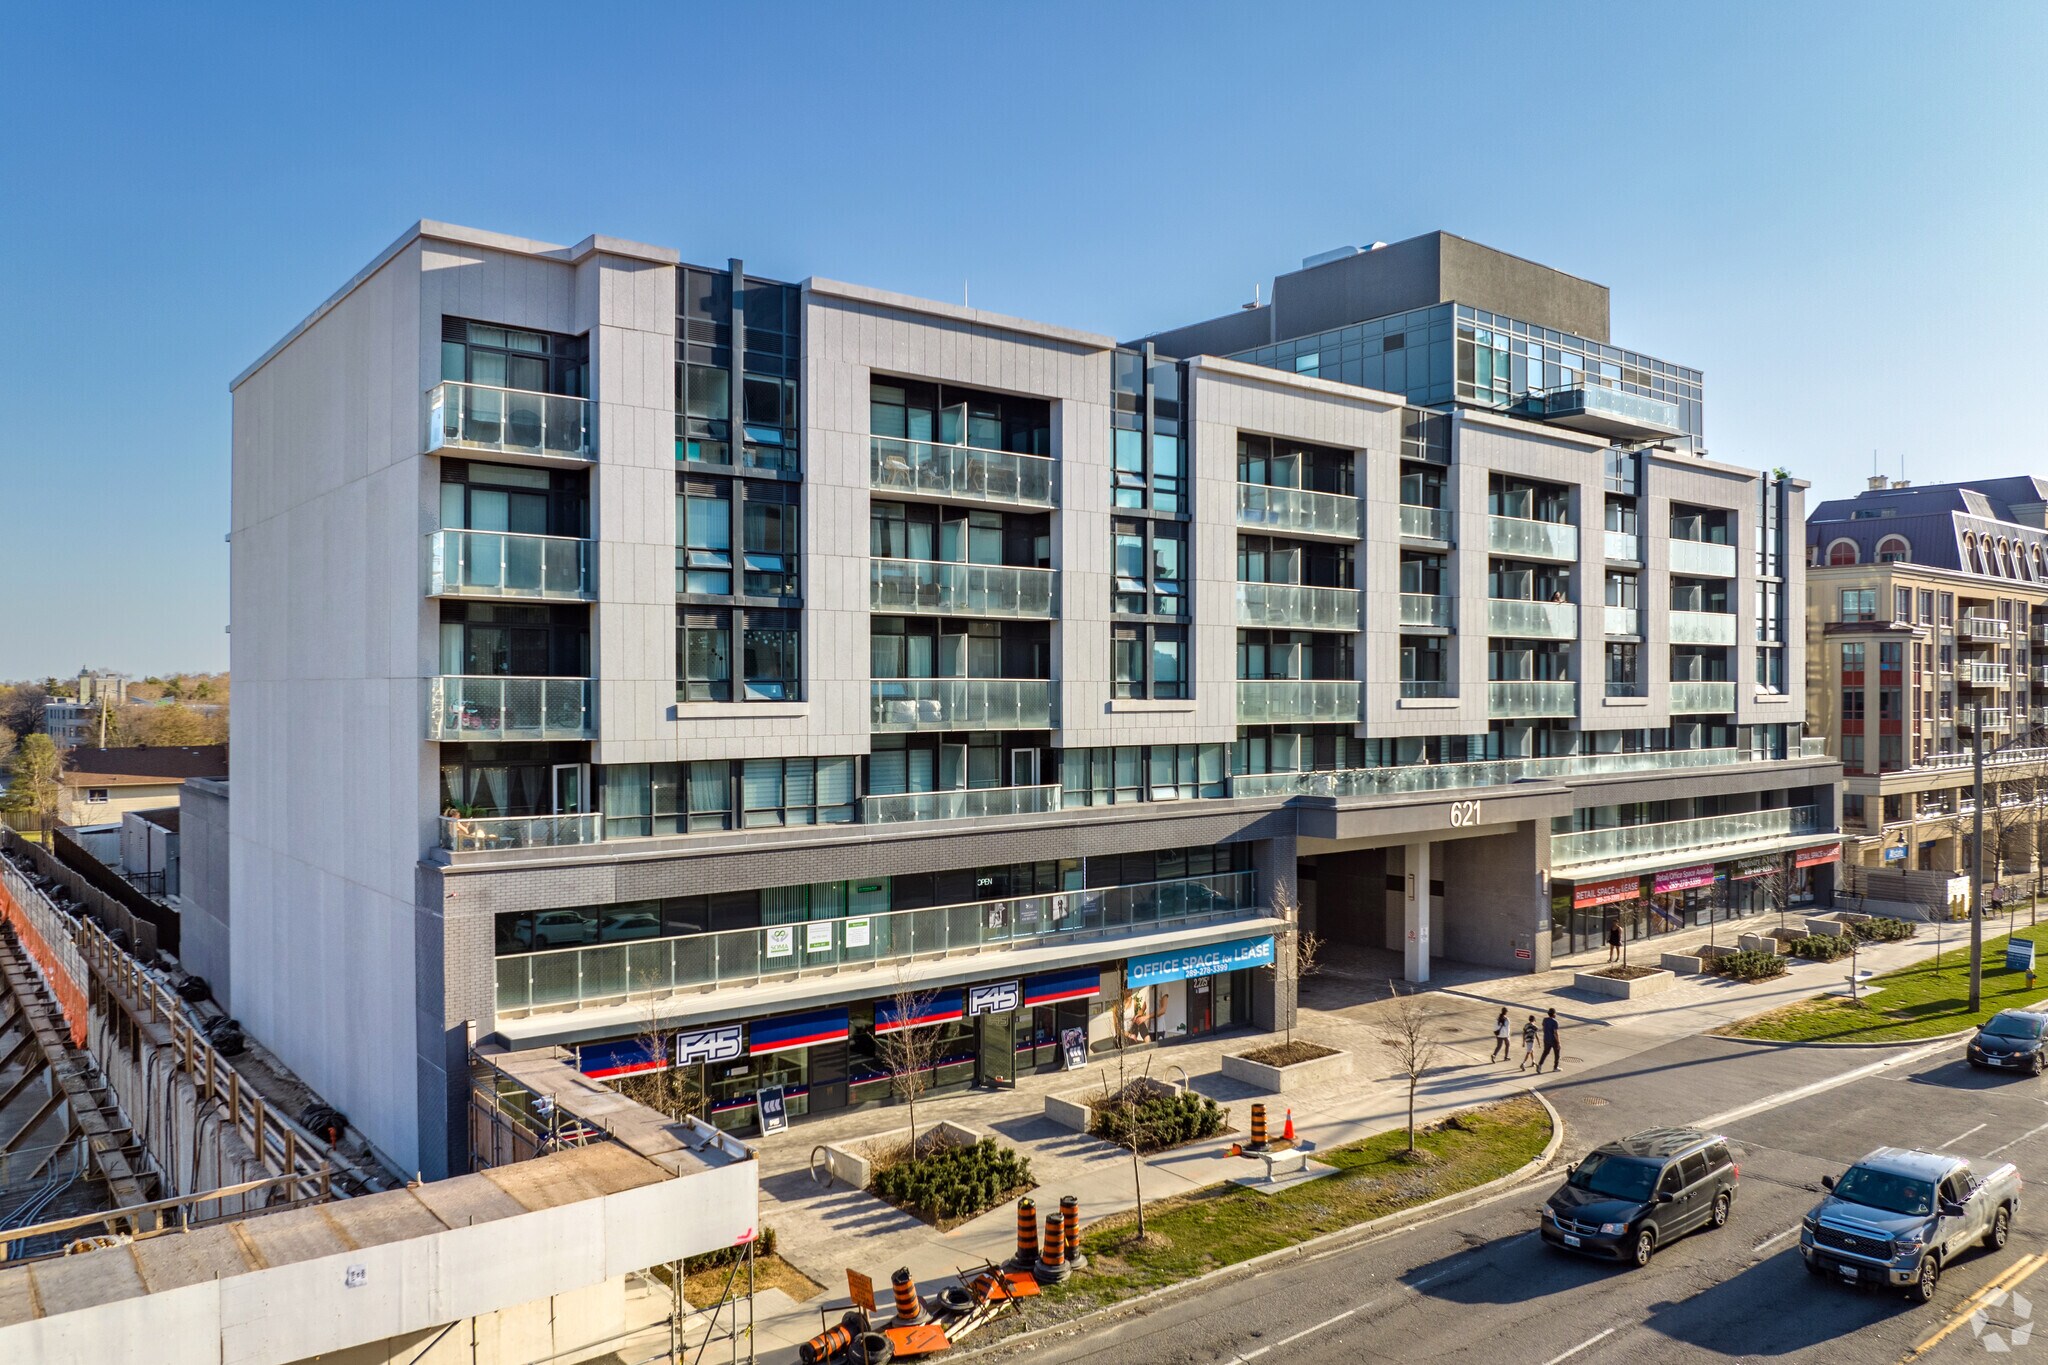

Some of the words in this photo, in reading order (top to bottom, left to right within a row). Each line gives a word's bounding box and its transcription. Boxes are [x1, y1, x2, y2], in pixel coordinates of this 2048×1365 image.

[1451, 800, 1480, 827] 621
[1811, 850, 1823, 859] SPACE
[977, 878, 993, 886] OPEN
[1576, 890, 1596, 900] RETAIL
[1597, 886, 1615, 897] SPACE
[1621, 882, 1638, 892] LEASE
[1133, 959, 1180, 979] OFFICE
[1182, 952, 1220, 971] SPACE
[1222, 954, 1233, 964] for
[1234, 943, 1270, 961] LEASE
[1185, 964, 1228, 978] 289-278-3399
[971, 982, 1017, 1014] F45
[679, 1027, 740, 1064] F45
